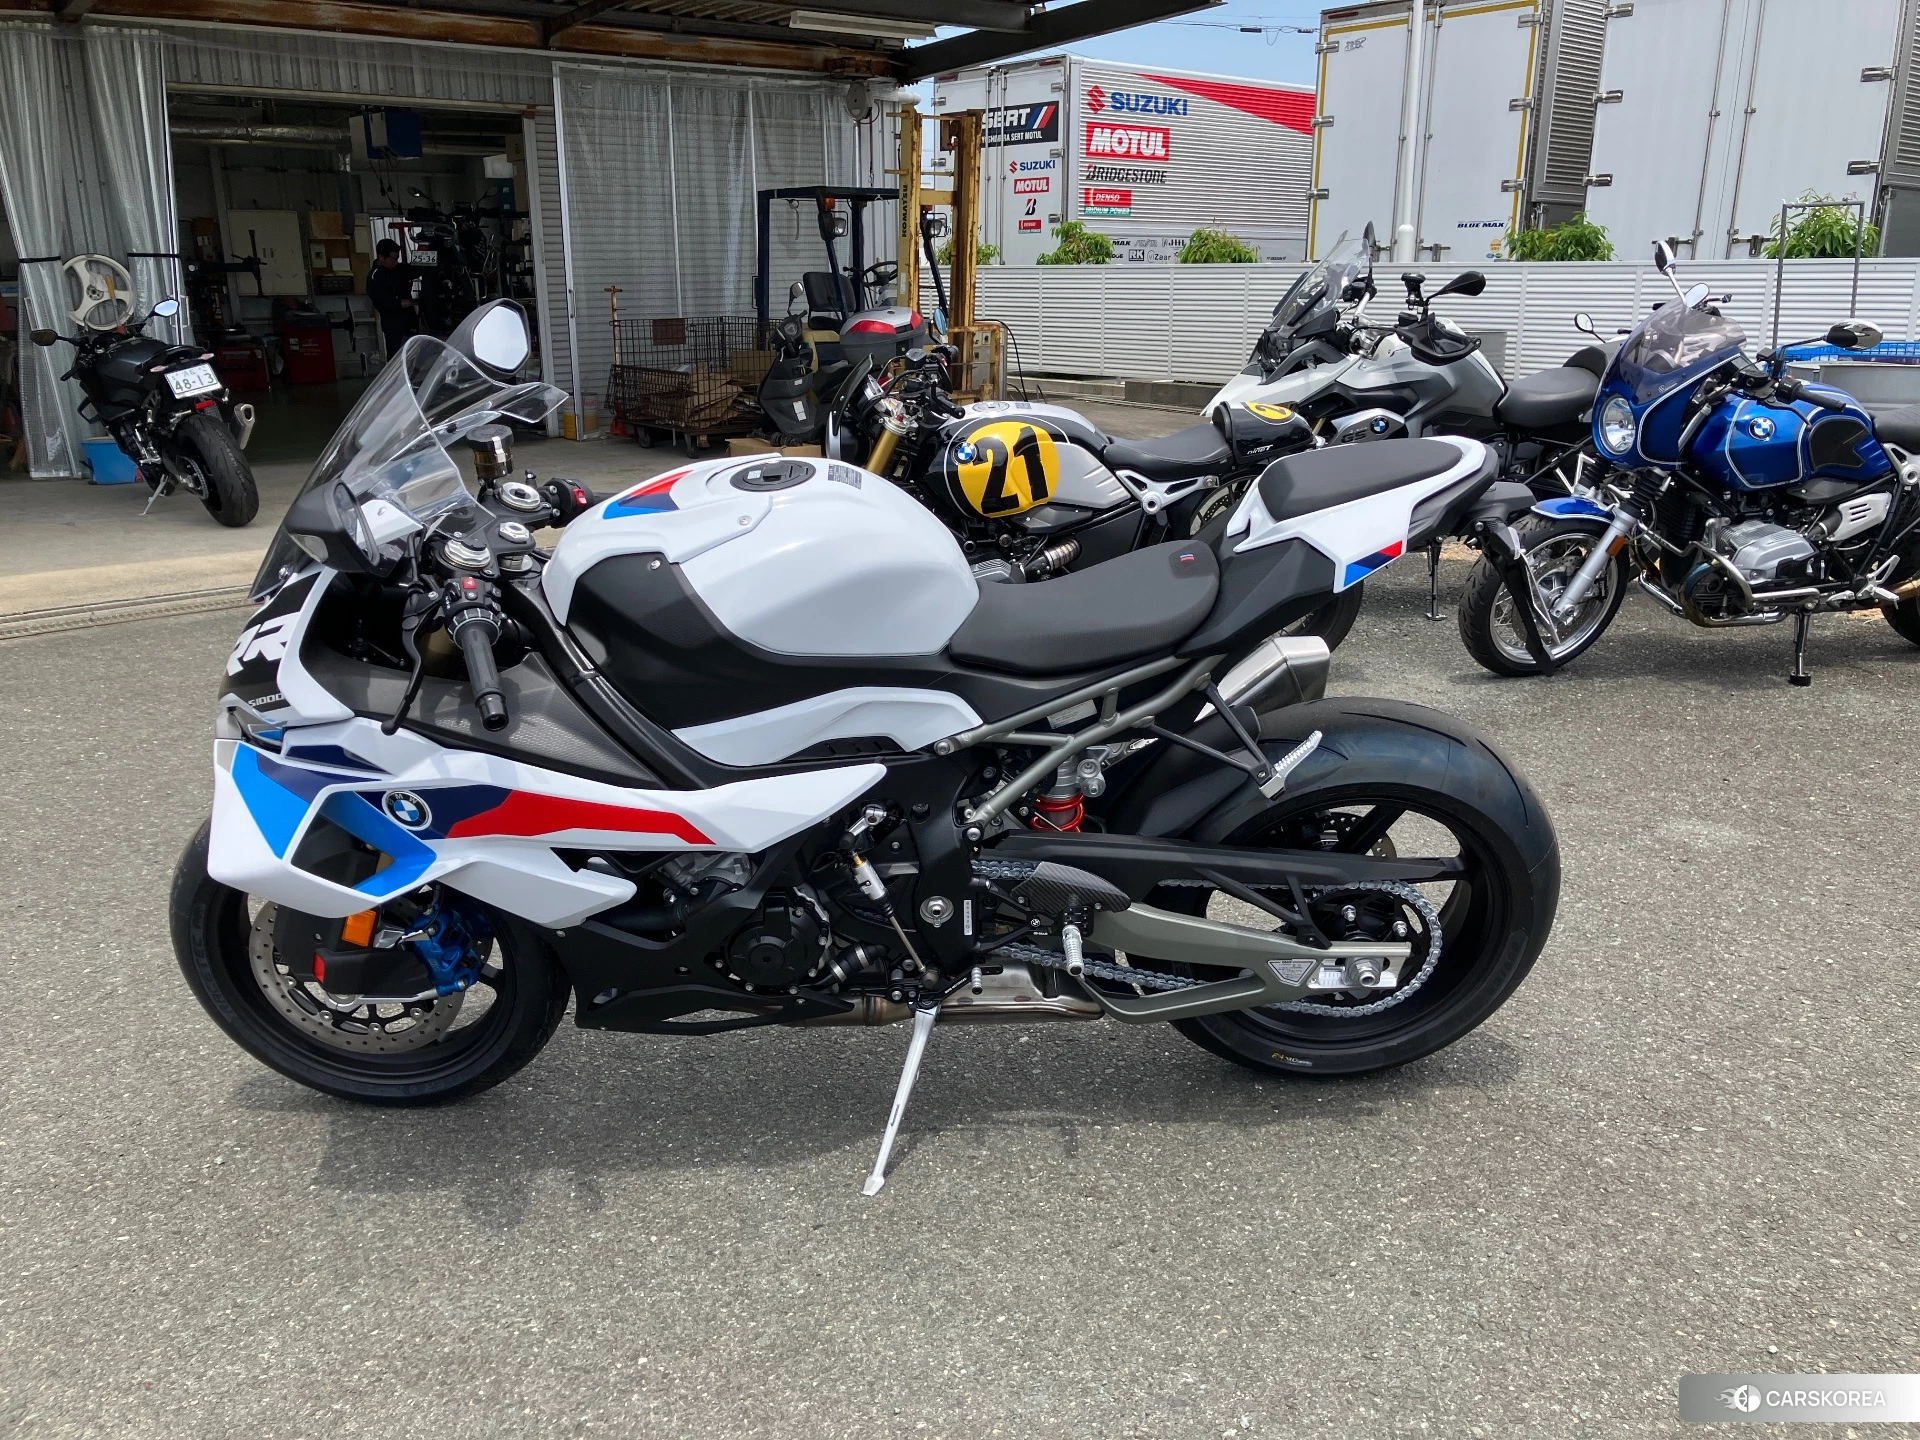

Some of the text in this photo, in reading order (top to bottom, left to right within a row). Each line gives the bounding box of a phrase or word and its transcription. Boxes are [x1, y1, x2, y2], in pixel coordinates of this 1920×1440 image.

[1110, 92, 1188, 116] SUZUKI
[982, 108, 1031, 129] SERT
[1025, 130, 1043, 140] MOTUL
[1089, 128, 1166, 156] MOTUL
[1020, 160, 1056, 171] SUZUKI
[1086, 164, 1168, 184] BRIDGESTONE
[1015, 180, 1048, 192] MOTUL
[1095, 193, 1120, 202] DENSO
[1129, 250, 1144, 259] RK
[972, 426, 1049, 514] 21
